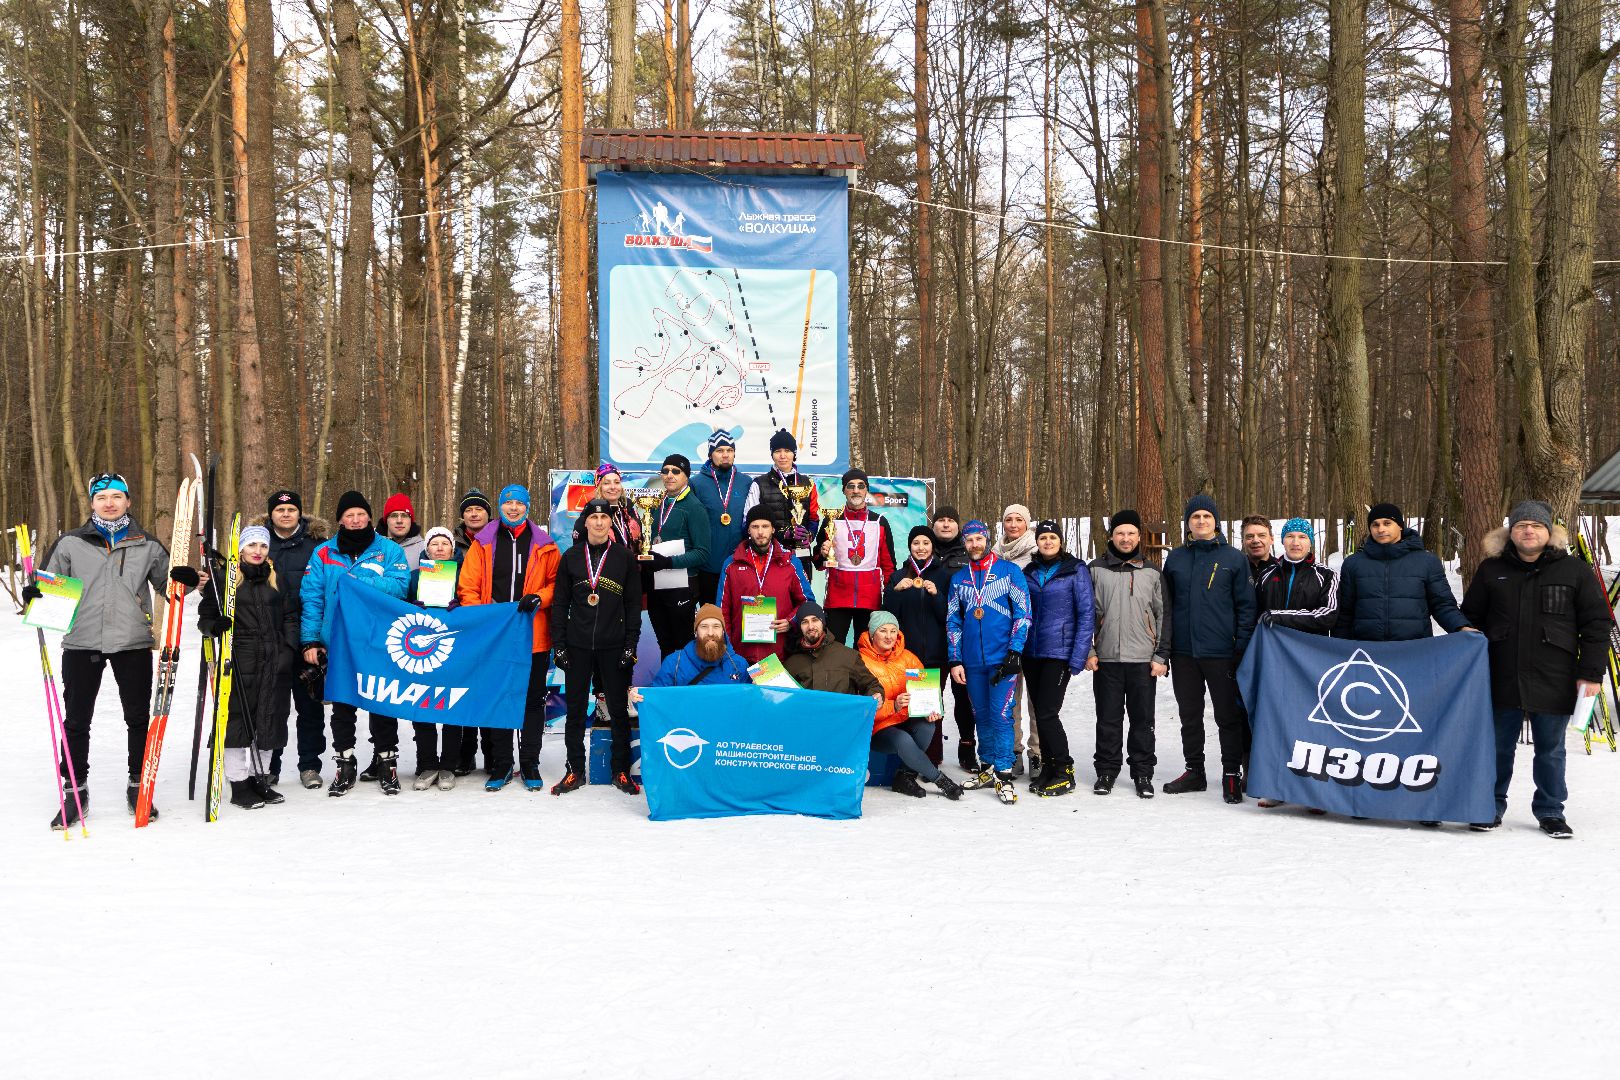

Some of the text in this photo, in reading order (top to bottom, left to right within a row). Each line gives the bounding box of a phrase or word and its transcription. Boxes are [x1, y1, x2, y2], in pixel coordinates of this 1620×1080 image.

[739, 212, 816, 222] Лыжная трасса
[739, 223, 817, 234] «ВОЛКУША»
[810, 398, 819, 449] Лыткарино
[884, 496, 907, 505] Sport
[227, 562, 238, 617] FISCHER
[730, 742, 784, 752] ТУРАЕВСКОЕ
[715, 750, 817, 763] МАШИНОСТРОИТЕЛЬНОЕ
[715, 759, 855, 775] КОНСТРУКТОРСКОЕ БЮРО «СОЮЗ»
[1286, 740, 1441, 792] ЛЗОС
